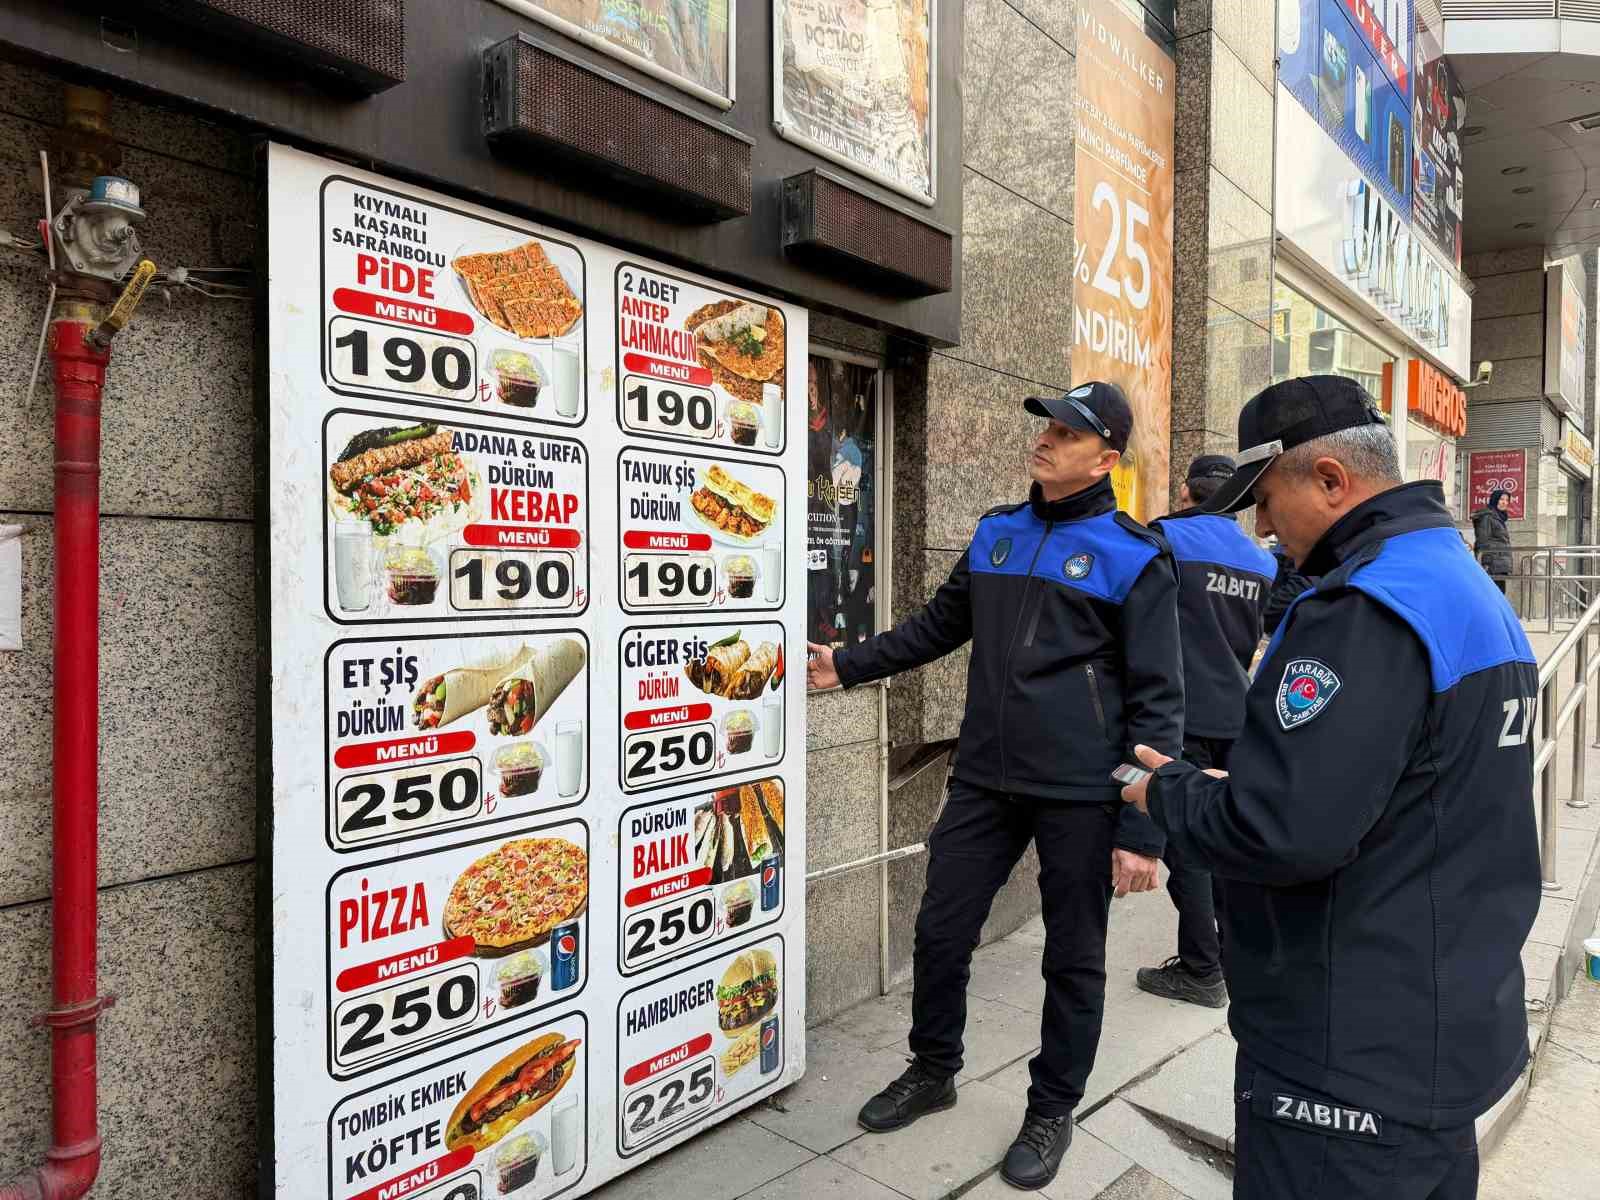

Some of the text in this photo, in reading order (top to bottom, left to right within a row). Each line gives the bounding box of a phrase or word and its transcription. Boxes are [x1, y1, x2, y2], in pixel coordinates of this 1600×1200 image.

[1078, 7, 1164, 96] VIDWALKER
[353, 192, 427, 226] KIYMALI
[354, 212, 427, 245] KAŞARLI
[332, 227, 446, 268] SAFRANBOLU
[623, 272, 680, 305] 2 ADET
[375, 301, 437, 325] MENÜ
[621, 295, 670, 324] ANTEP
[621, 317, 697, 362] LAHMACUN
[335, 329, 472, 391] 190
[650, 364, 690, 380] MENÜ
[627, 385, 713, 431] 190
[451, 431, 582, 464] ADANA & URFA
[488, 461, 554, 489] DÜRÜM
[622, 459, 696, 493] TAVUK ŞİŞ
[490, 488, 579, 524] KEBAP
[630, 492, 681, 522] DÜRÜM
[498, 529, 550, 545] MENÜ
[649, 536, 689, 548] MENÜ
[454, 559, 570, 600] 190
[628, 562, 713, 598] 190
[624, 631, 679, 668] CİGER
[342, 647, 418, 695] ET ŞİŞ
[638, 672, 679, 701] DÜRÜM
[1291, 664, 1335, 688] KARABÜK
[337, 698, 404, 738] DÜRÜM
[650, 707, 689, 725] MENÜ
[376, 737, 439, 761] MENÜ
[627, 731, 714, 779] 250
[340, 767, 479, 833] 250
[631, 807, 687, 838] DÜRÜM
[633, 832, 689, 880] BALIK
[650, 875, 690, 899] MENÜ
[339, 877, 430, 949] PİZZA
[627, 899, 714, 961] 250
[377, 945, 439, 979] MENÜ
[339, 974, 476, 1057] 250
[626, 978, 714, 1037] HAMBURGER
[649, 1045, 689, 1073] MENÜ
[338, 1071, 467, 1141] TOMBİK EKMEK
[627, 1064, 713, 1133] 225
[1276, 1096, 1378, 1135] ZABITA
[346, 1119, 441, 1184] KÖFTE
[378, 1162, 439, 1200] MENÜ
